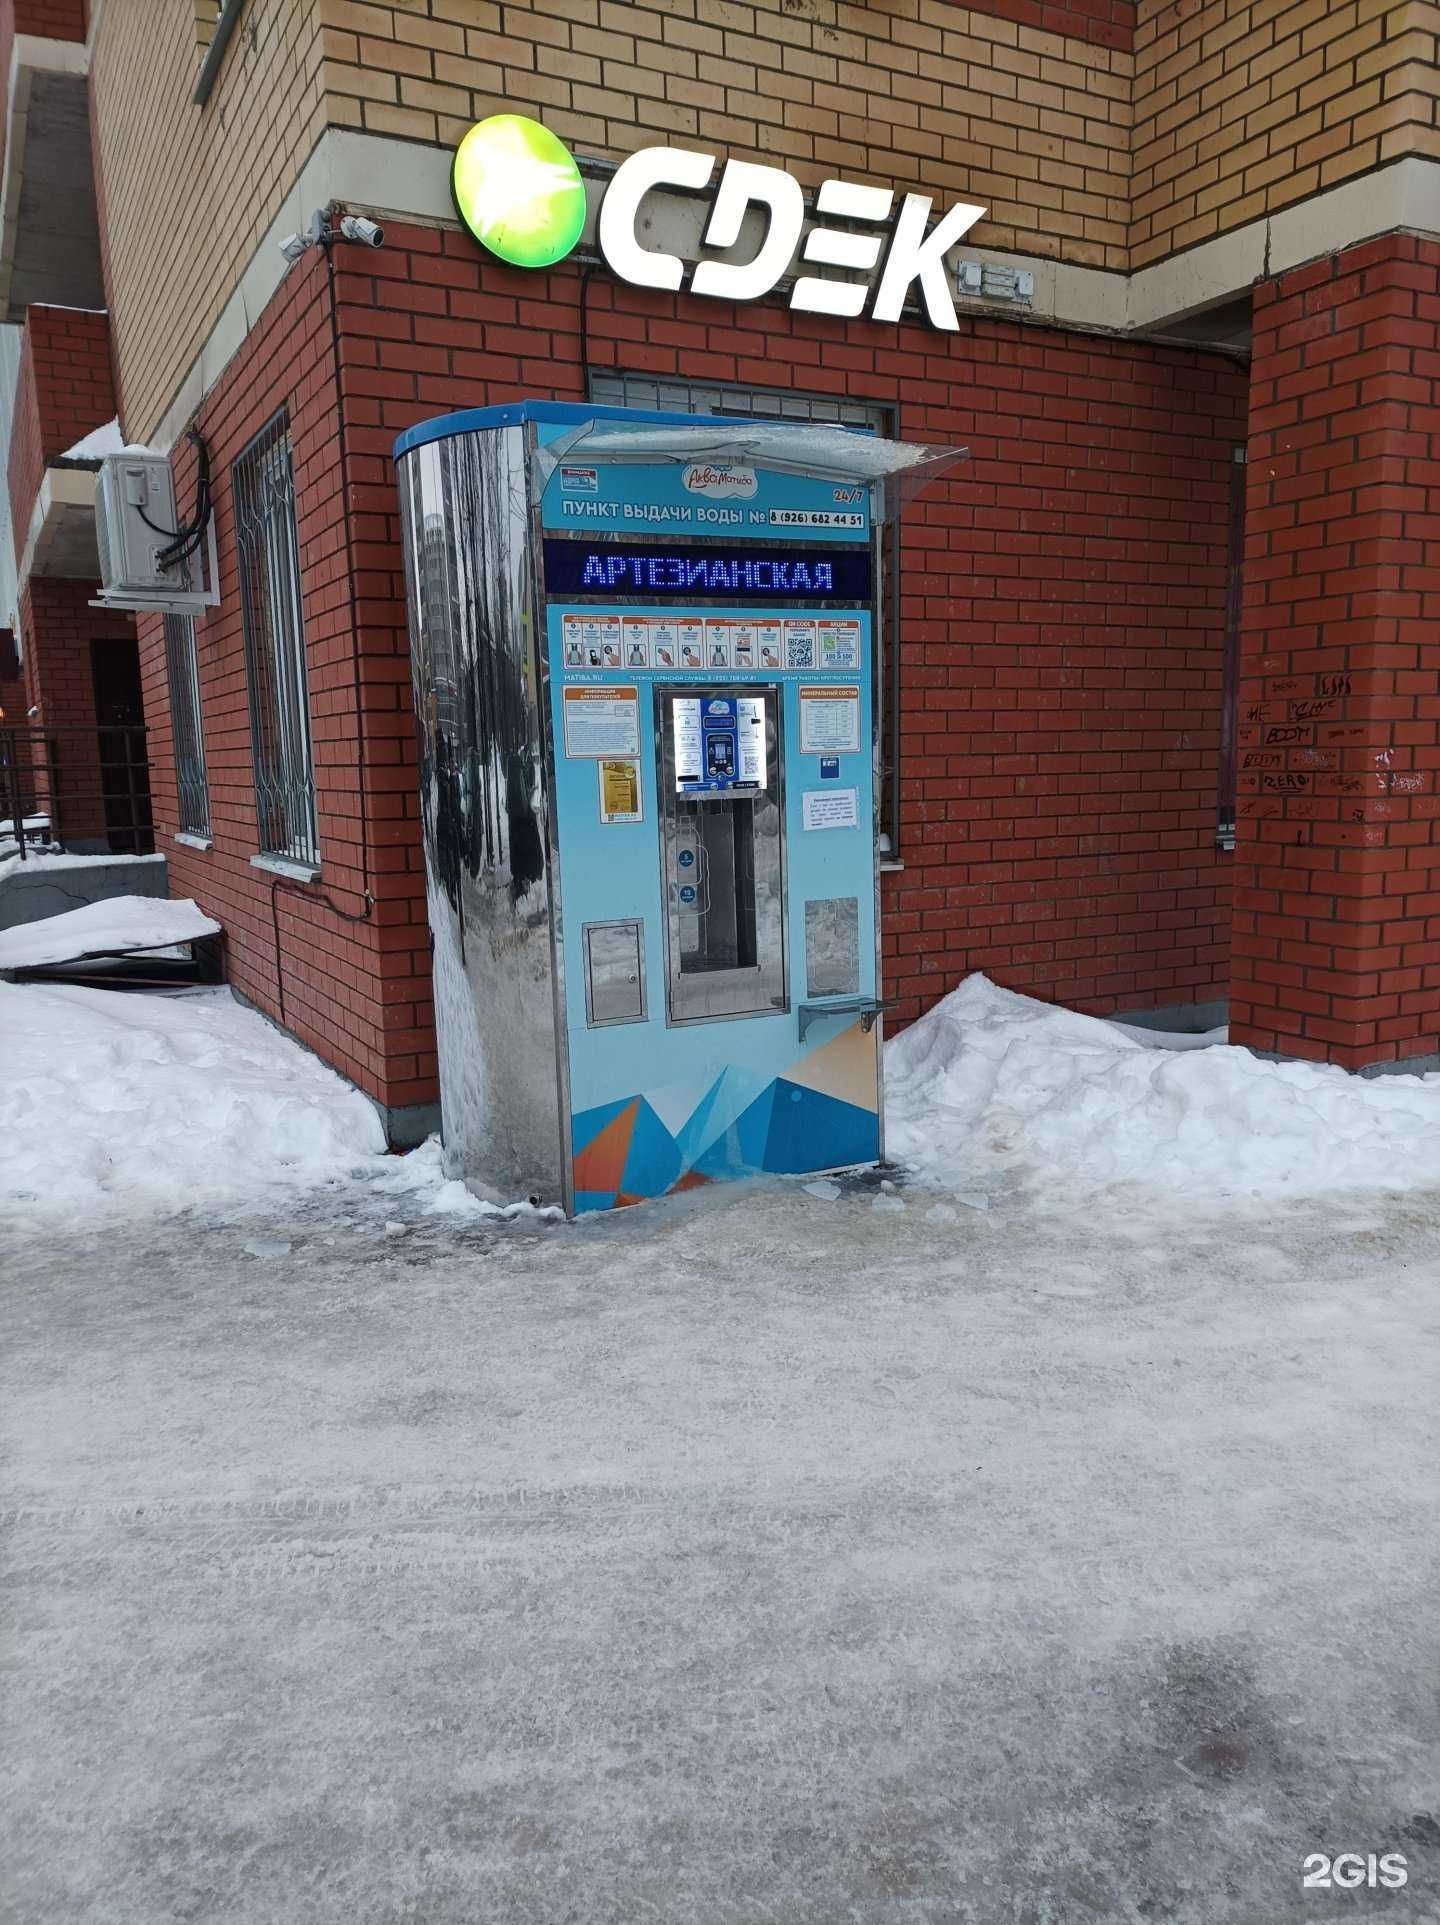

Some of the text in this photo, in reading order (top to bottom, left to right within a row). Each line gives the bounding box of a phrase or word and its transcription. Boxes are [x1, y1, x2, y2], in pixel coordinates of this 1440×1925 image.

[599, 146, 988, 331] CDEK
[833, 488, 863, 504] 24/7
[562, 500, 863, 525] ПУНКТ ВЫДАЧИ ВОДЫ № 8 (926) 682 44 51
[584, 555, 832, 590] АРТЕЗИАНСКАЯ
